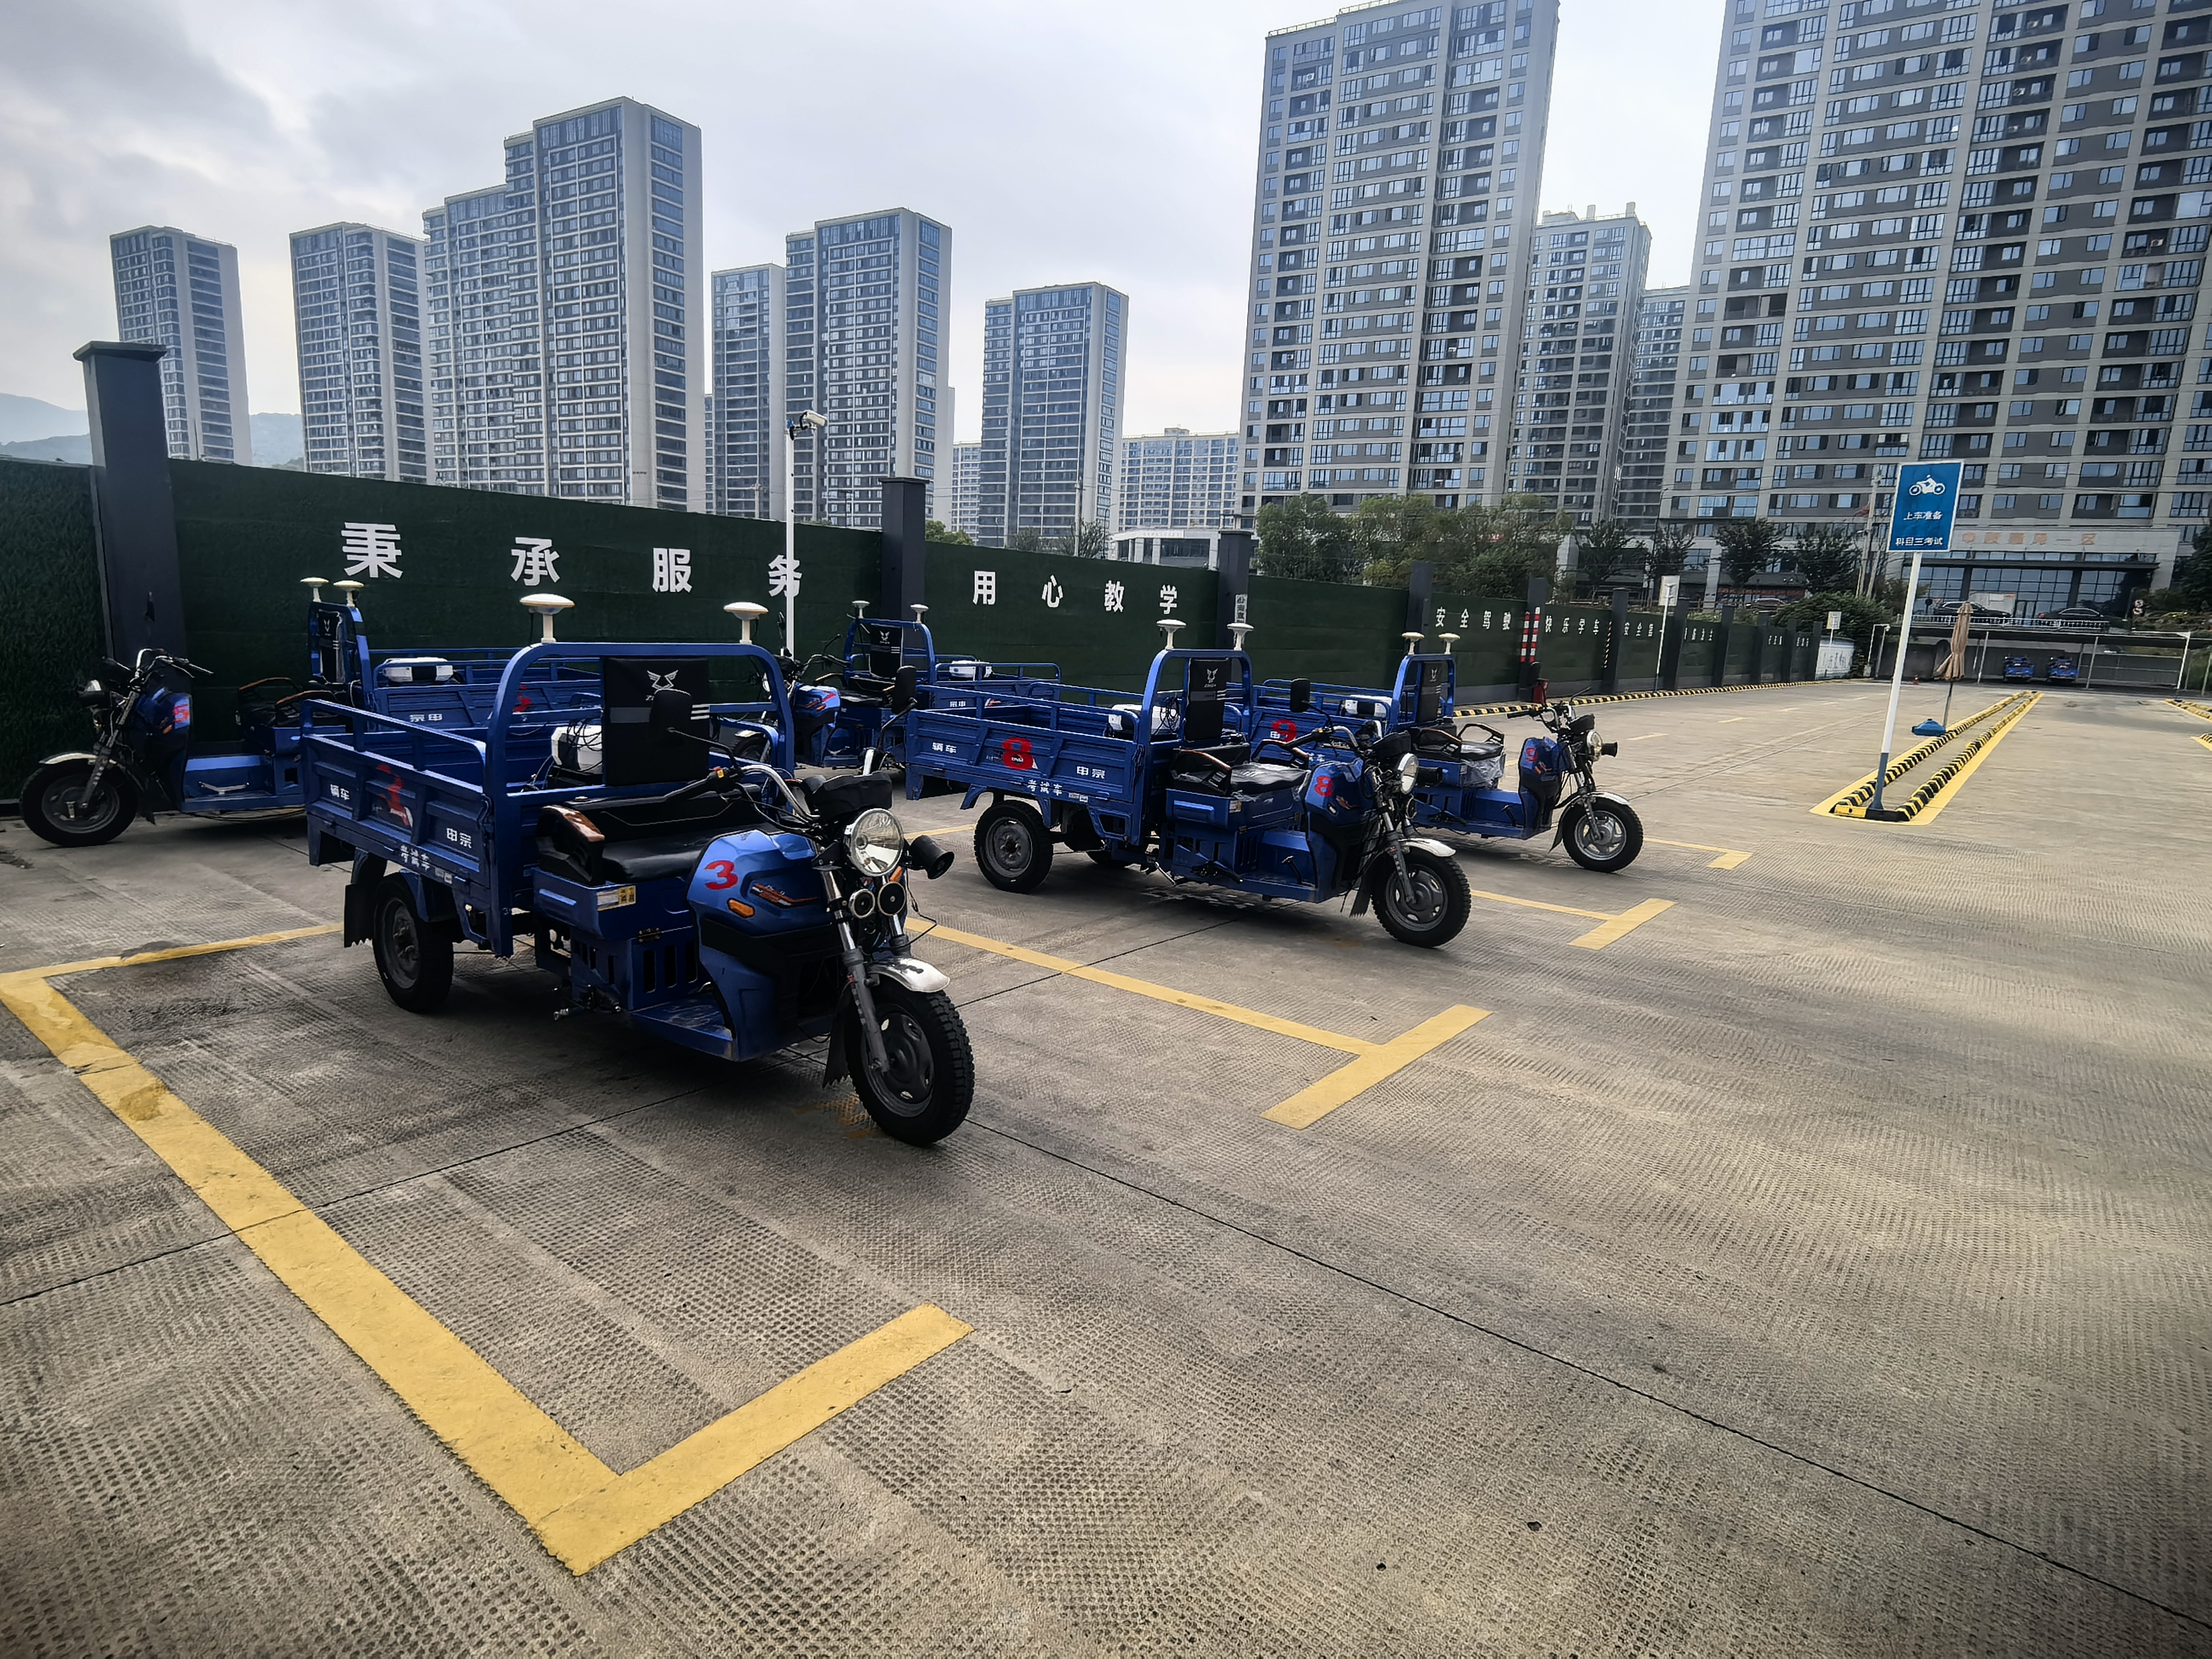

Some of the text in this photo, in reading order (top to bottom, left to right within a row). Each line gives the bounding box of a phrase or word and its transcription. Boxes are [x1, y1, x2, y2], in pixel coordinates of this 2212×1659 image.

[1903, 511, 1943, 520] 上车准备
[1895, 537, 1943, 546] 科目三考试
[973, 570, 1178, 614] 用心教学
[1271, 719, 1298, 743] 9
[1002, 737, 1033, 771] 8
[1525, 747, 1538, 762] 9
[1315, 776, 1333, 797] 8
[704, 860, 739, 890] 3
